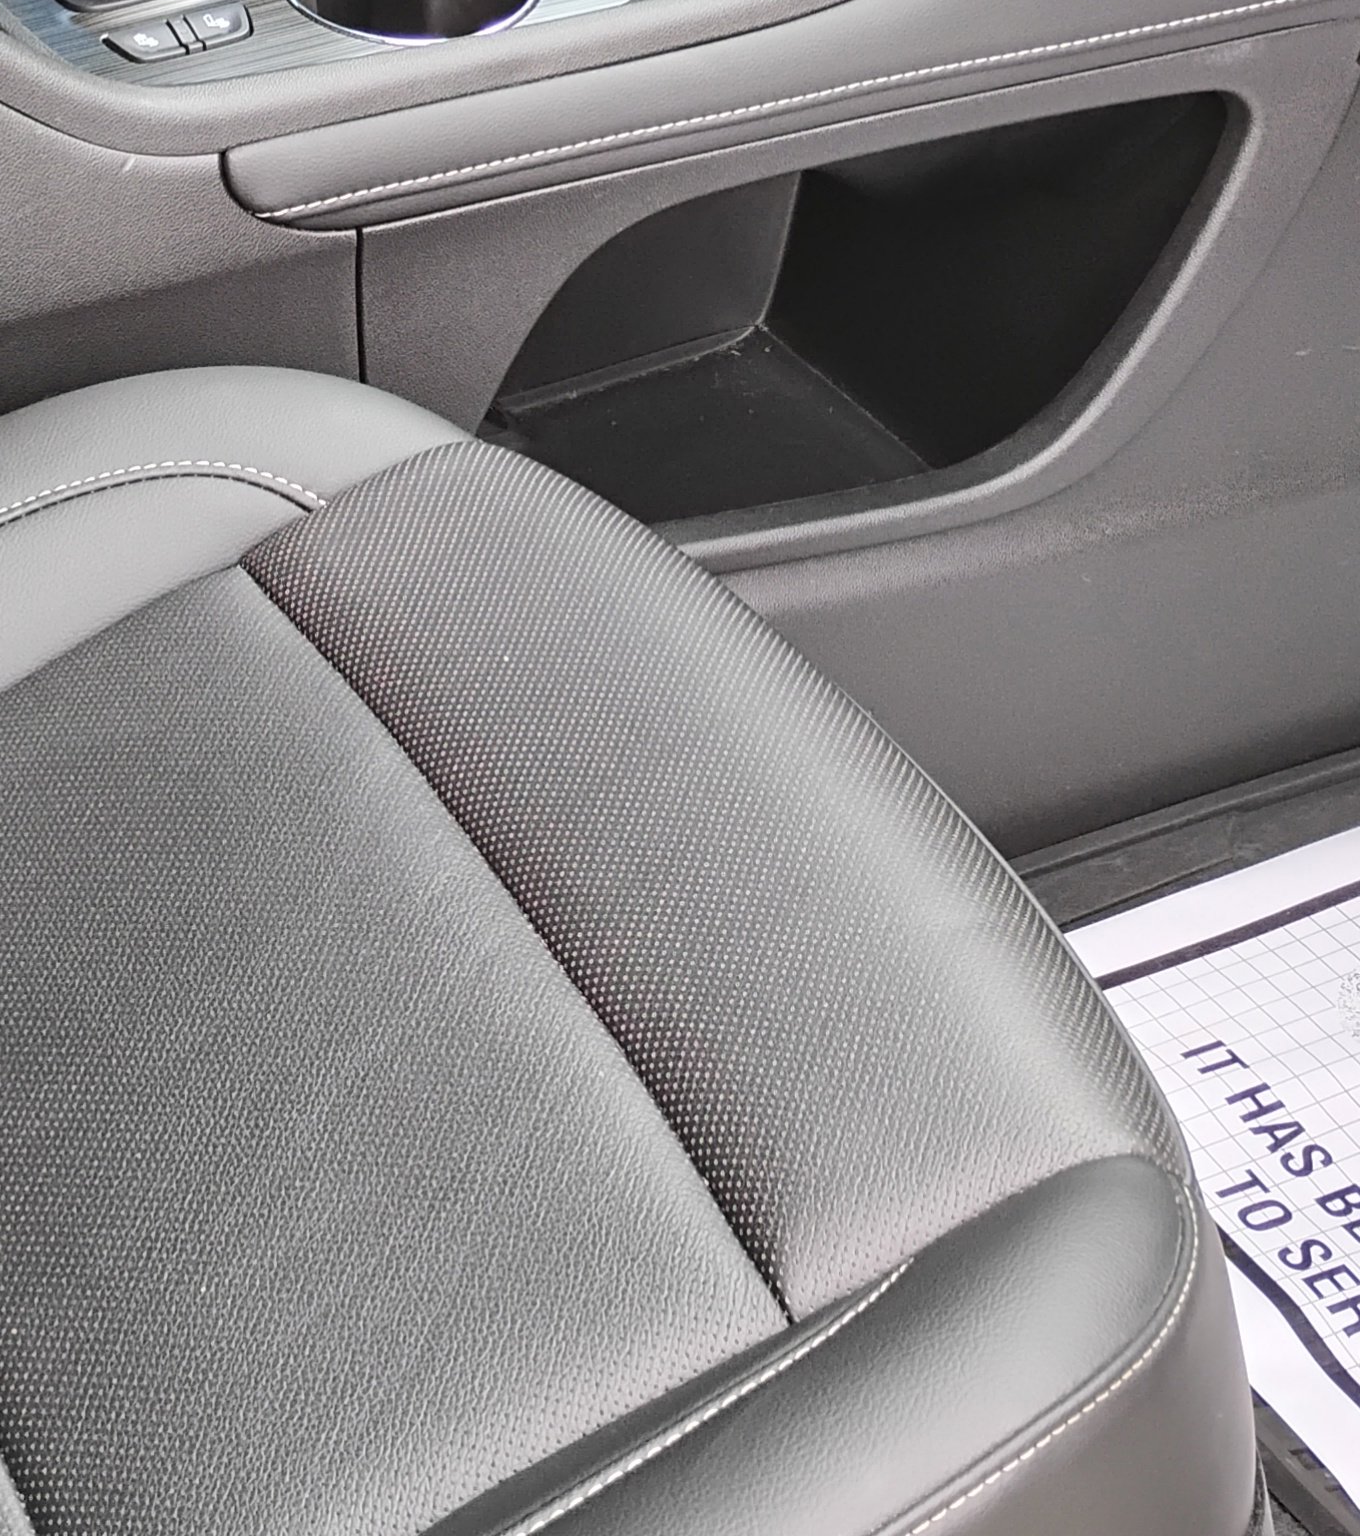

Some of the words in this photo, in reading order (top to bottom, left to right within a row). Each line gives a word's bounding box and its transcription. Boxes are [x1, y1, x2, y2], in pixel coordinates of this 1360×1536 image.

[1181, 1040, 1249, 1074] IT
[1225, 1082, 1333, 1177] HAS
[1215, 1169, 1293, 1231] TO
